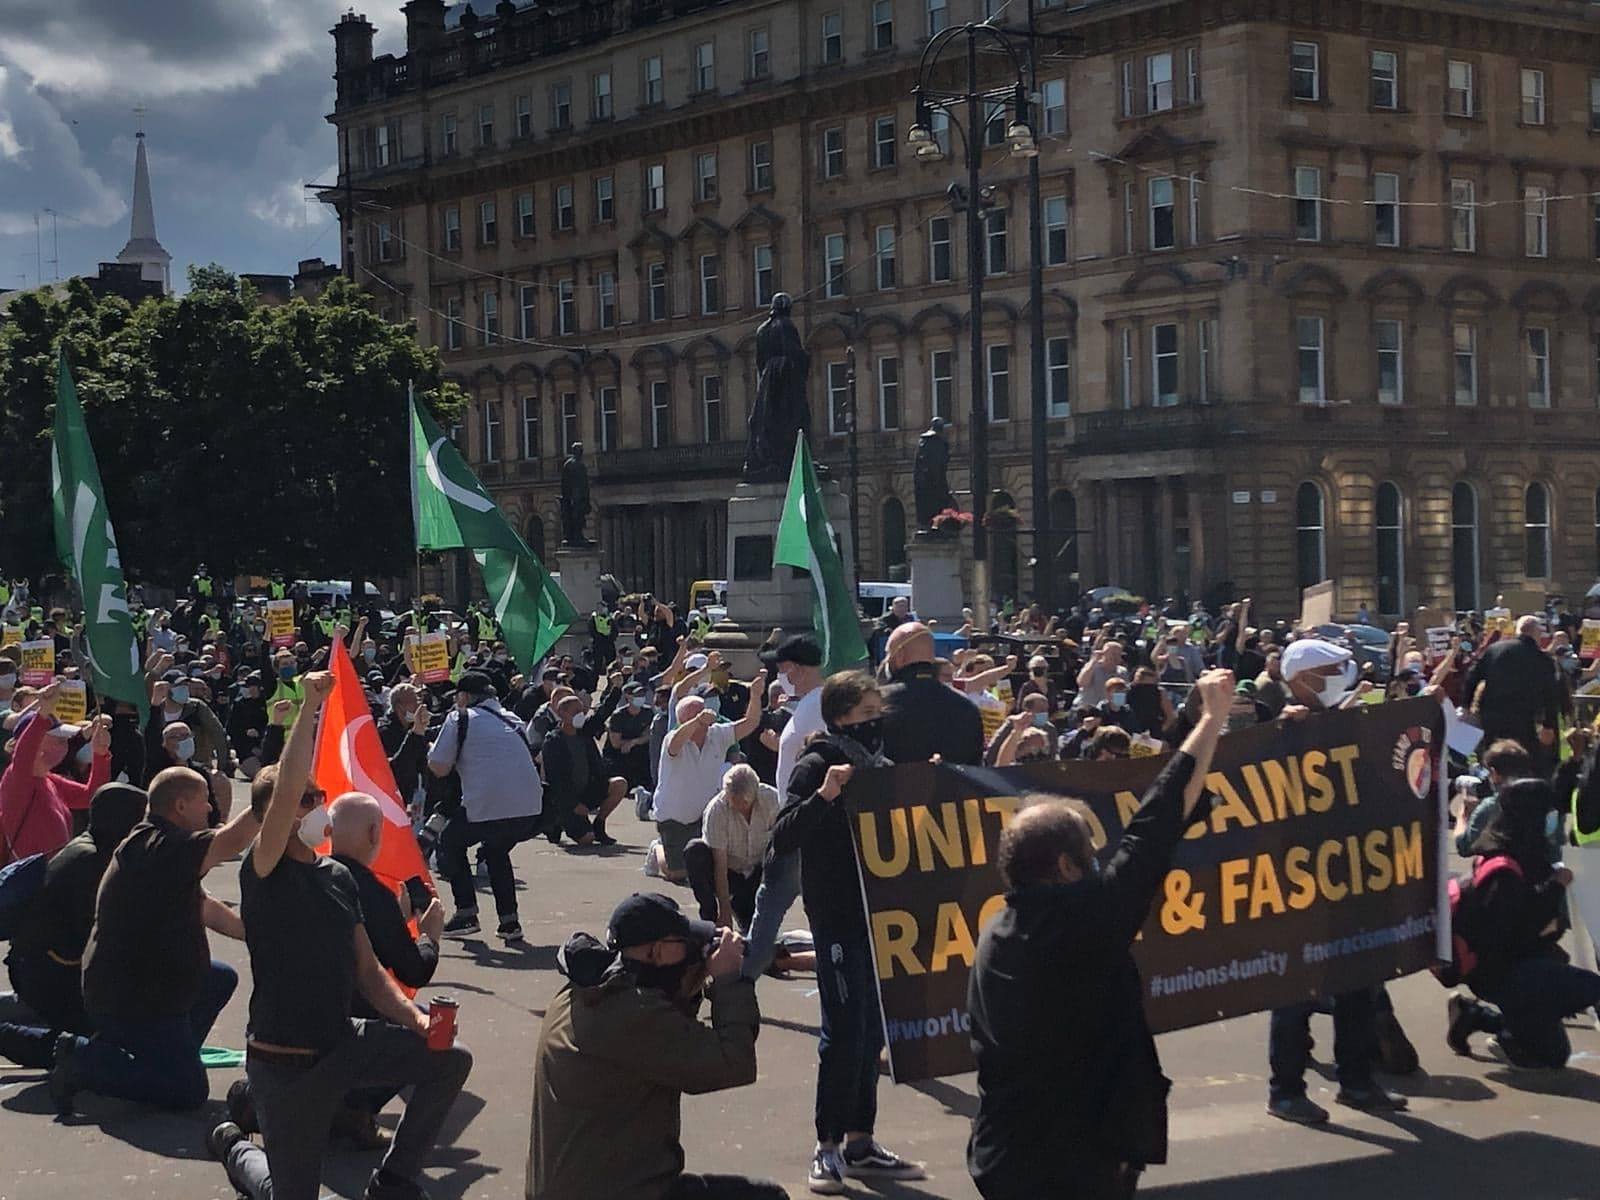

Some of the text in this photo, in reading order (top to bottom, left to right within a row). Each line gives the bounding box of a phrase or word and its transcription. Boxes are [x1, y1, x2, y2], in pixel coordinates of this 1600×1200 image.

[858, 744, 1360, 878] UNIT AINST
[1160, 868, 1207, 935] &
[1220, 821, 1425, 925] FASCISM
[1151, 949, 1288, 998] #unions4unity
